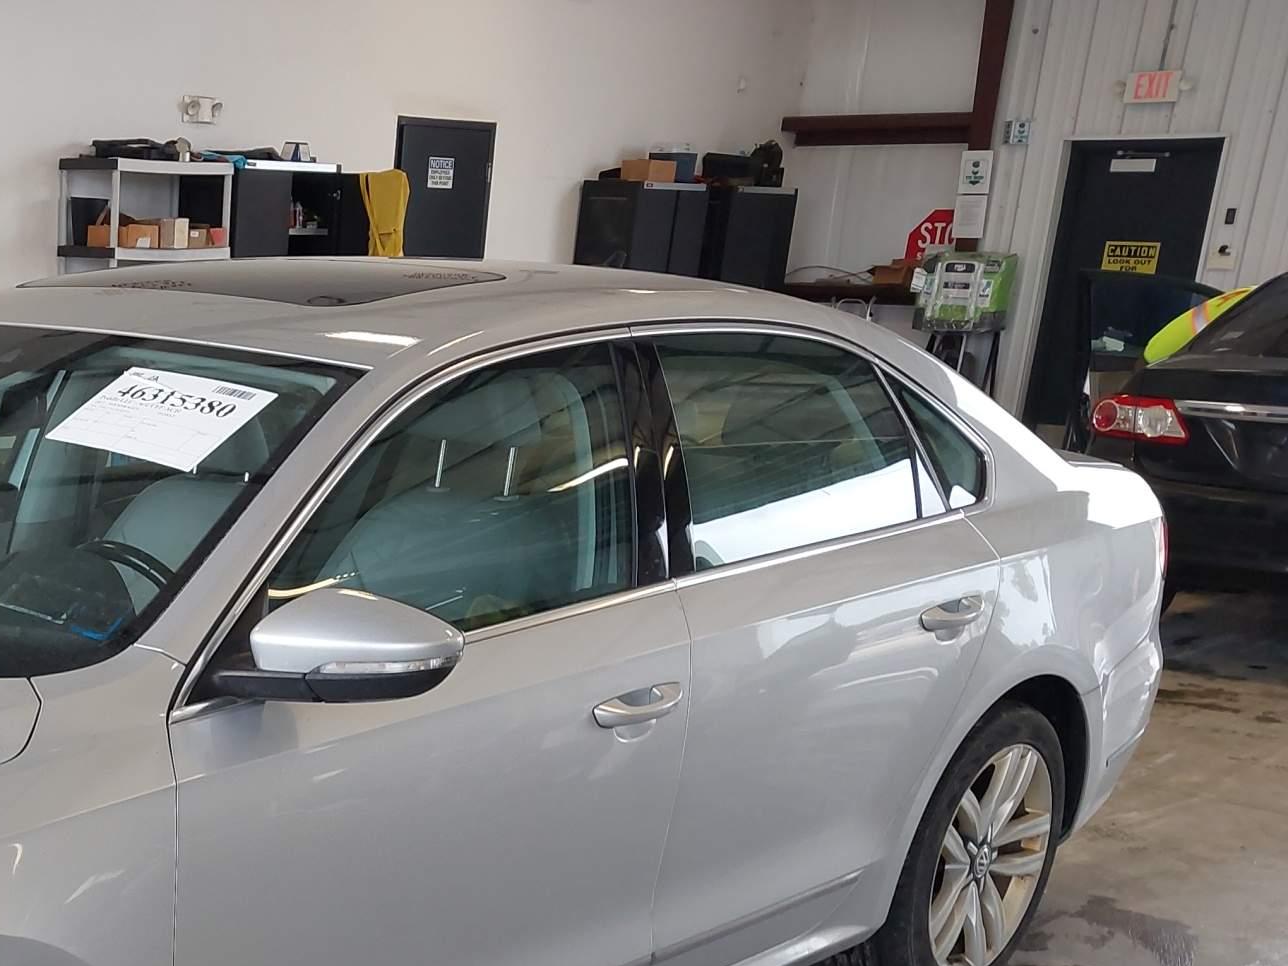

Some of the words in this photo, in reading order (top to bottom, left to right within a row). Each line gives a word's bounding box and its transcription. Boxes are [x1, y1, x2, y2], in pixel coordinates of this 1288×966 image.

[1134, 71, 1173, 100] EXIT
[431, 160, 453, 168] NOTICE
[1108, 246, 1156, 257] CAUTION
[118, 384, 237, 418] 46315380
